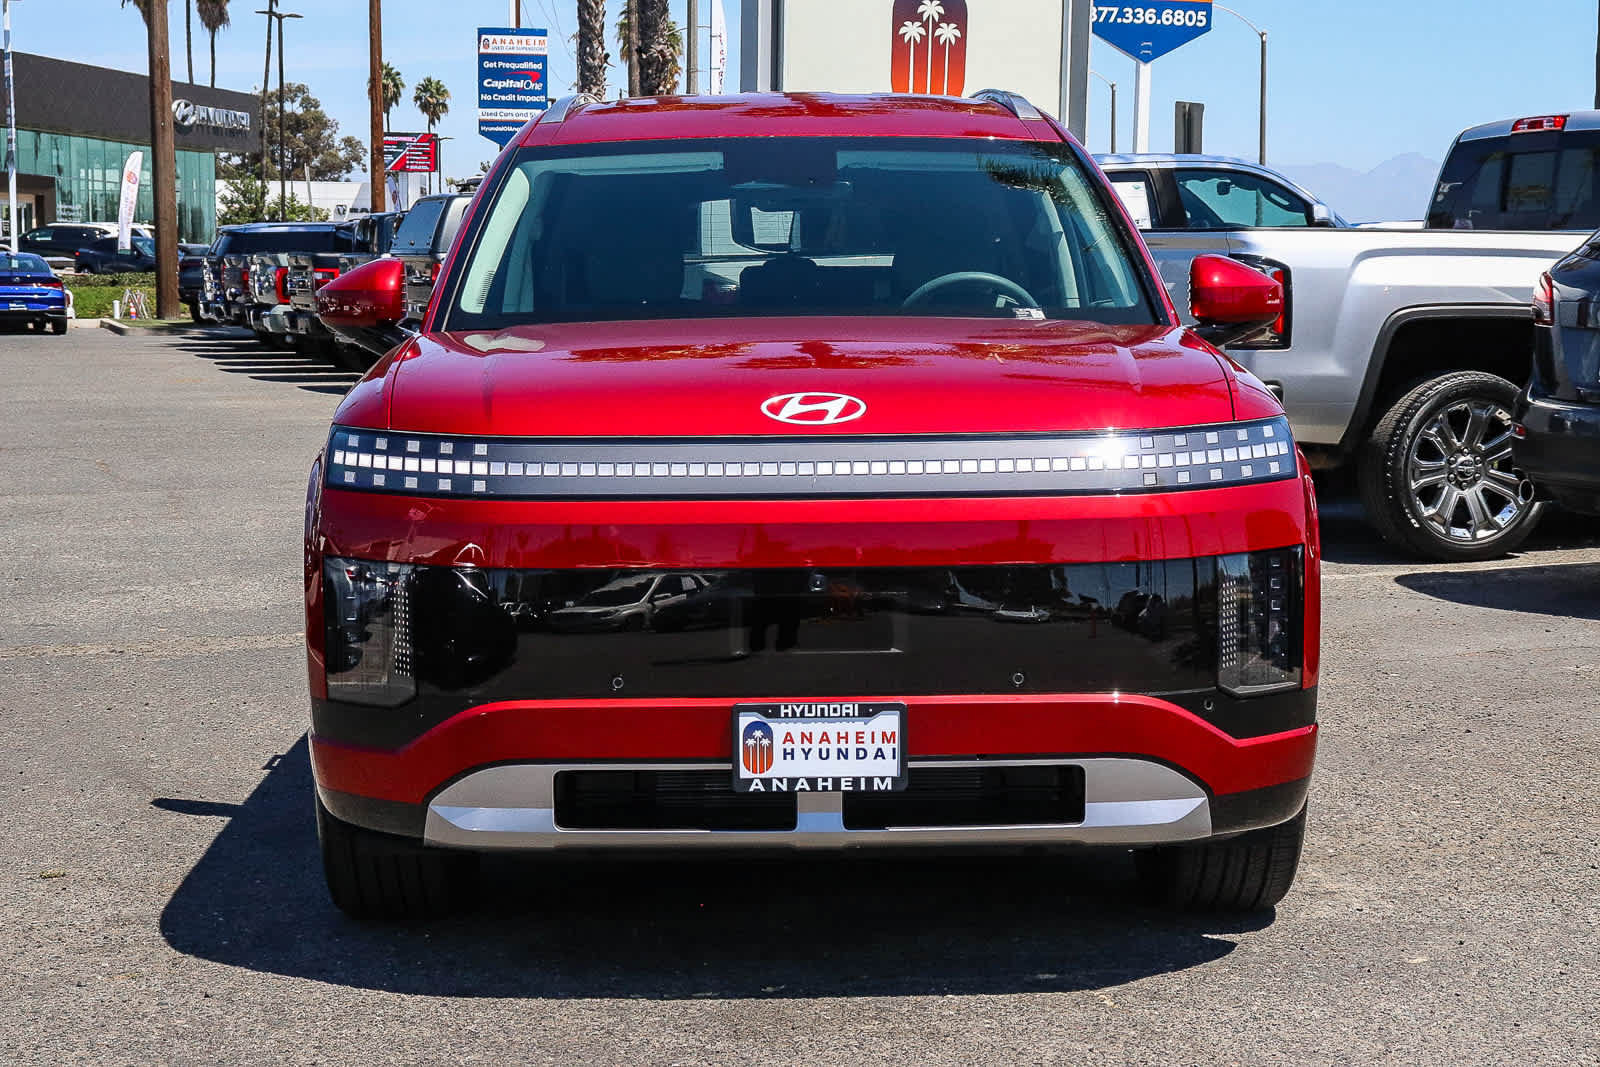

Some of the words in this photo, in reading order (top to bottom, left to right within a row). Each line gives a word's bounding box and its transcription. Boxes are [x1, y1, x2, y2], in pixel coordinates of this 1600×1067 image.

[491, 38, 546, 46] ANAHEIM
[498, 61, 542, 70] Prequalified
[517, 94, 546, 102] Impact
[780, 703, 858, 717] HYUNDAI
[782, 731, 896, 744] ANAHEIM
[783, 747, 897, 760] HYUNDAI
[748, 777, 893, 791] ANAHEIM
